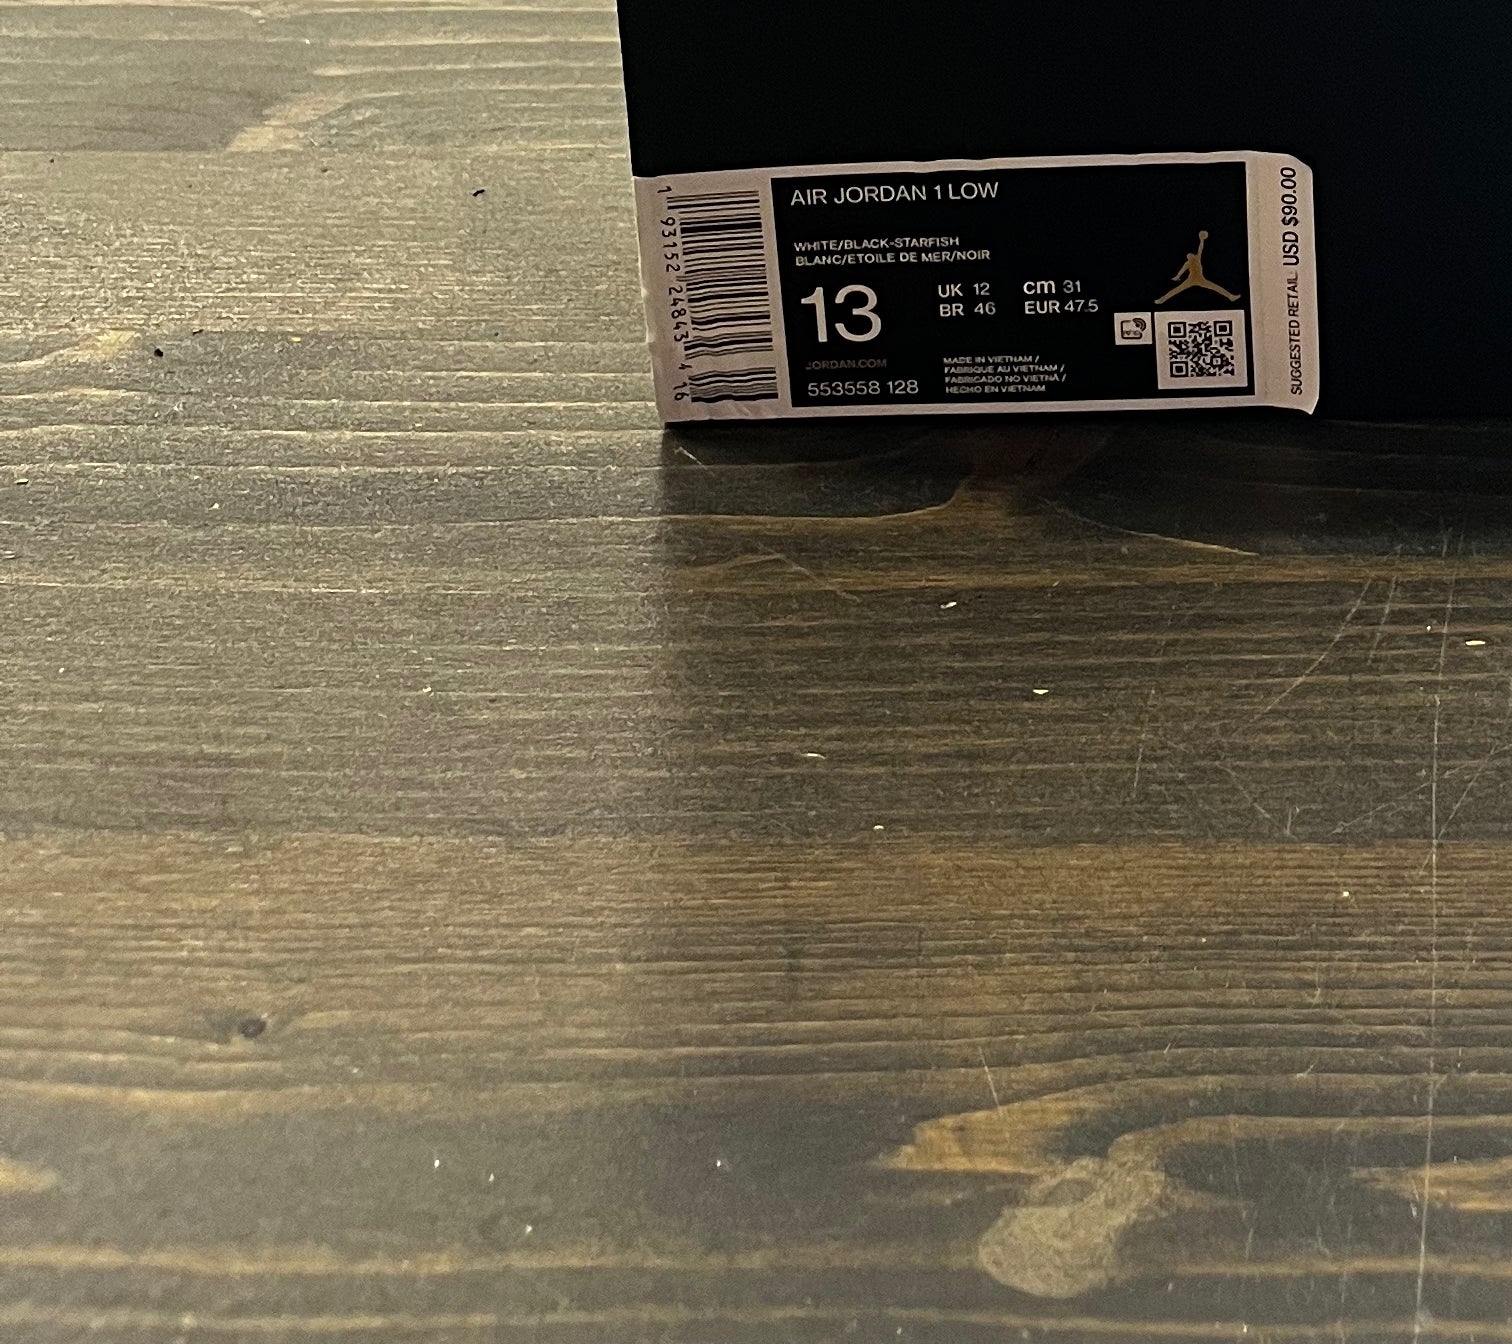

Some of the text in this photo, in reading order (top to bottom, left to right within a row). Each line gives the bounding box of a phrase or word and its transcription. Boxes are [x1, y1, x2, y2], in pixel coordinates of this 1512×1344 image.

[790, 181, 999, 206] AIR JORDAN 1 LOW
[1279, 166, 1300, 227] $90.00
[660, 216, 681, 273] 93152
[793, 236, 960, 252] WHITE/BLACK-STARFISH
[1282, 230, 1300, 266] USD
[795, 249, 992, 267] BLANC/ETOILE DE MER/NOIR
[937, 282, 991, 298] UK 12
[1022, 279, 1082, 295] cm 31
[668, 285, 690, 342] 24843
[800, 283, 882, 343] 13
[939, 302, 996, 317] BR 46
[1023, 298, 1100, 315] EUR 47.5
[804, 358, 888, 371] JORDAN.COM
[943, 356, 973, 365] MADE
[987, 354, 1033, 363] VIETNAM
[1289, 319, 1303, 396] SUGGESTED
[1012, 364, 1058, 373] VIETNAM
[807, 379, 920, 397] 553558 128
[1000, 384, 1046, 393] VIETNAM
